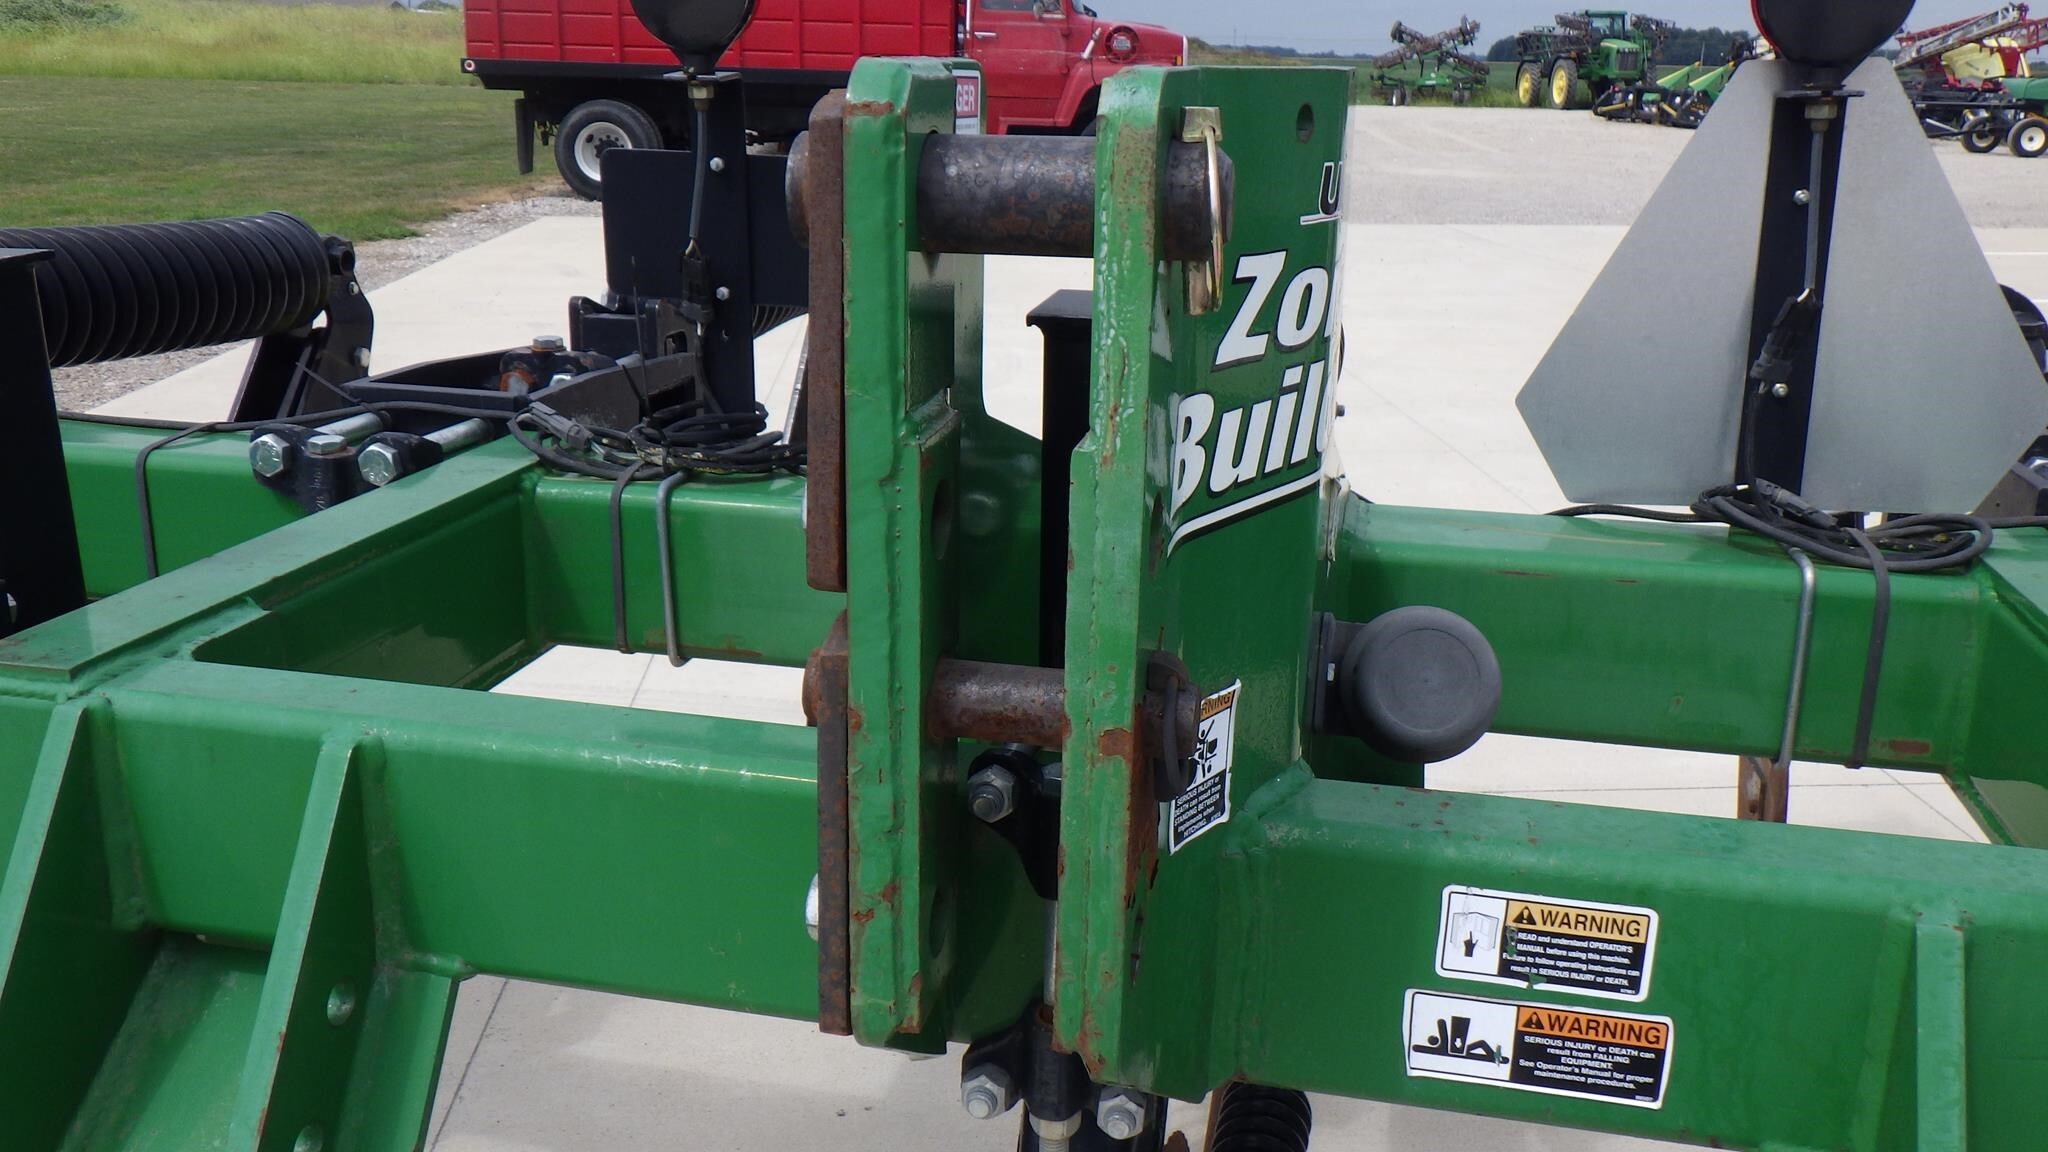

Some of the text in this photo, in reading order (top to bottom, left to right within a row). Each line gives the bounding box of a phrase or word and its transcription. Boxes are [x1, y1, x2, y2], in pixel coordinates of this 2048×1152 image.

[956, 84, 975, 112] GER
[1169, 359, 1332, 520] Buil
[1200, 692, 1231, 716] RNING
[1541, 908, 1641, 938] WARNING
[1516, 943, 1545, 954] MANUAL
[1545, 947, 1567, 956] before
[1567, 950, 1587, 960] using
[1587, 952, 1600, 961] this
[1517, 931, 1537, 941] READ
[1551, 937, 1588, 948] understand
[1589, 940, 1634, 953] OPERATOR'S
[1538, 967, 1570, 979] SERIOUS
[1570, 972, 1596, 982] INJURY
[1555, 960, 1587, 971] operating
[1547, 1012, 1661, 1045] WARNING
[1524, 1035, 1563, 1047] SERIOUS
[1564, 1040, 1596, 1051] INJURY
[1608, 1046, 1639, 1057] DEATH
[1639, 1051, 1656, 1059] can
[1547, 1047, 1631, 1064] result from FALLING
[1519, 1059, 1655, 1085] See Operator's Manual for proper
[1560, 1056, 1614, 1069] EQUIPMENT.
[1533, 1070, 1587, 1082] maintenance
